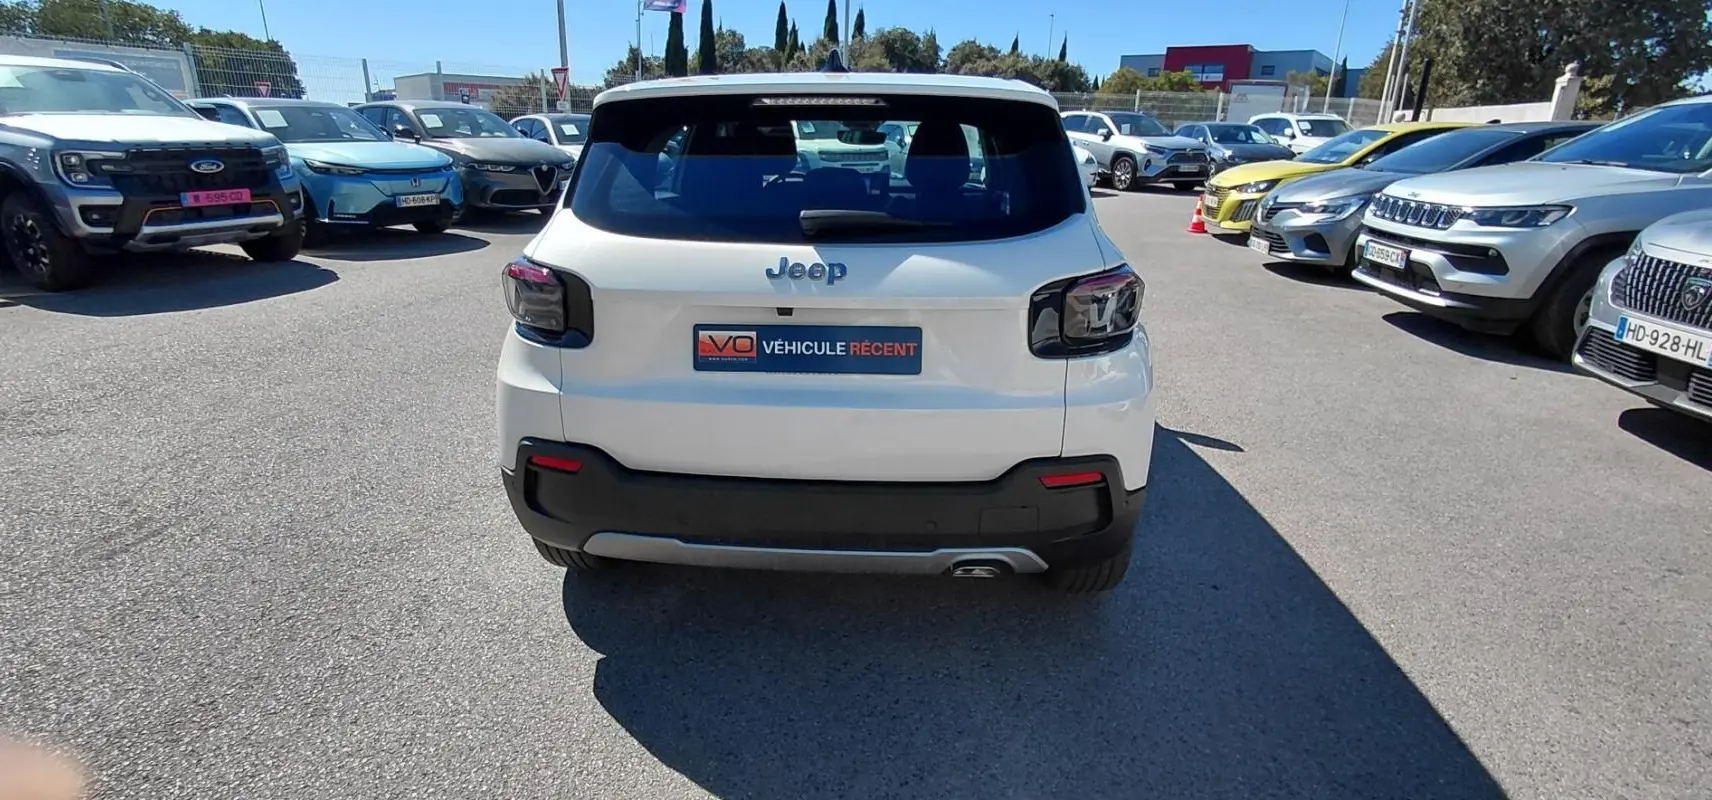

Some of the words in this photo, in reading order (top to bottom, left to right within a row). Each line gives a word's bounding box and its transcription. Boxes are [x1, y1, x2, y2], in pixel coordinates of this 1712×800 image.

[765, 256, 847, 285] Jeep
[708, 335, 754, 353] VO
[762, 338, 846, 356] VÉHICULE
[849, 340, 918, 357] RÉCENT
[1626, 321, 1707, 361] HD-928-HL
